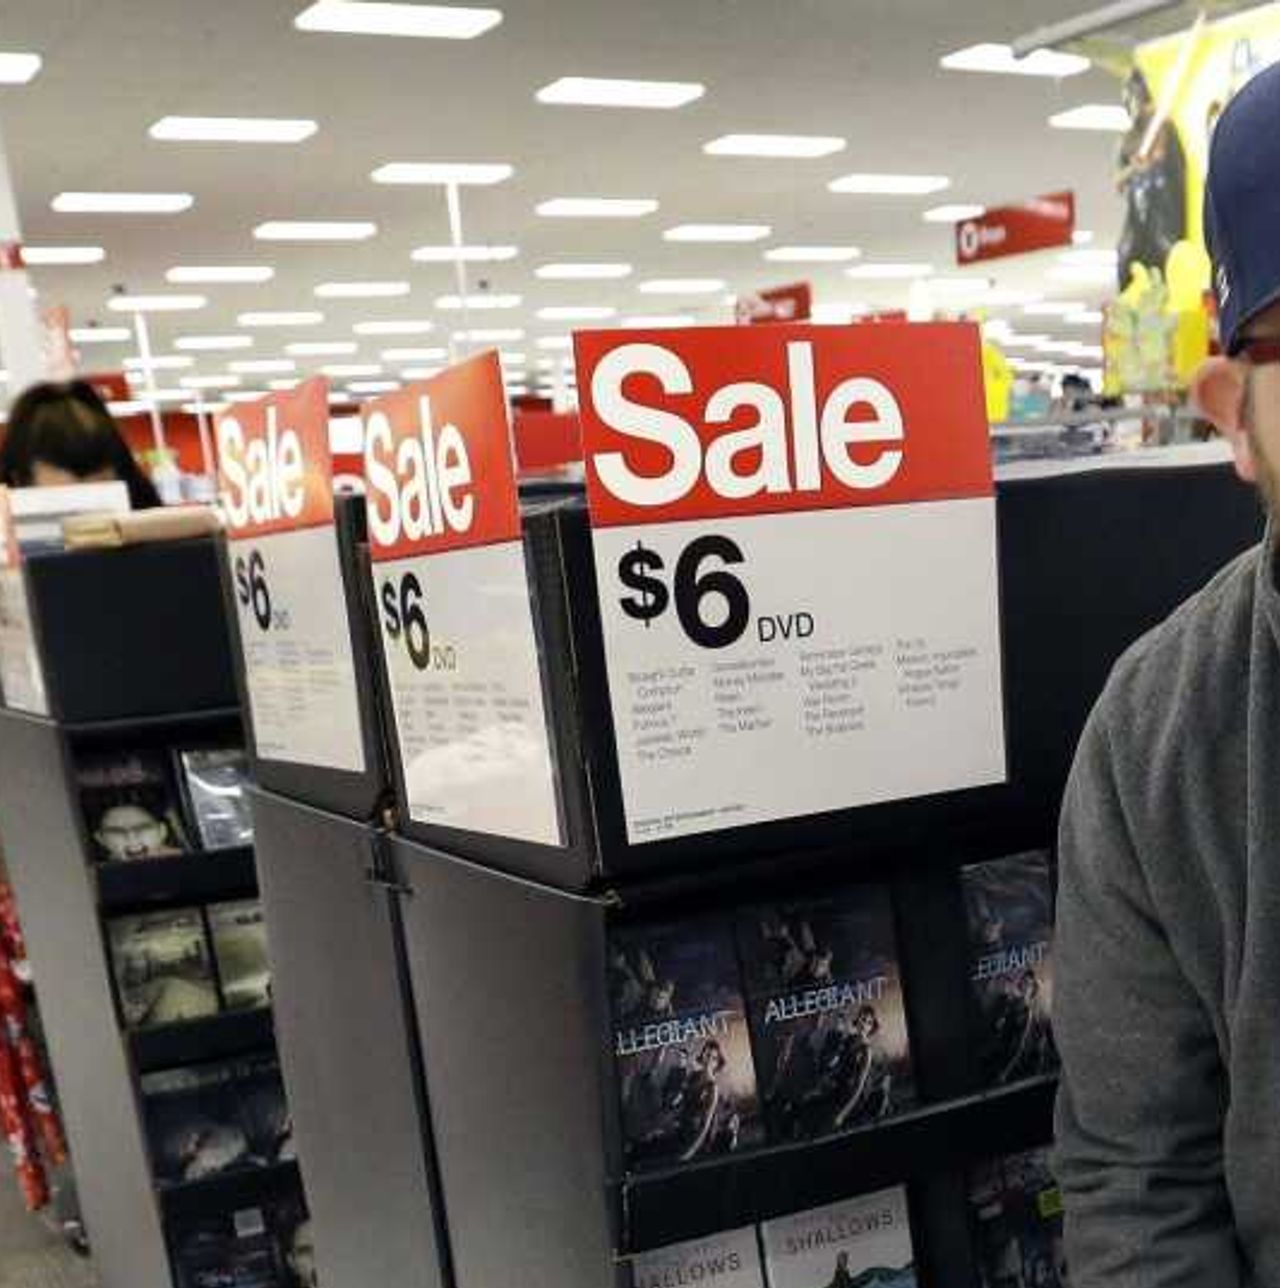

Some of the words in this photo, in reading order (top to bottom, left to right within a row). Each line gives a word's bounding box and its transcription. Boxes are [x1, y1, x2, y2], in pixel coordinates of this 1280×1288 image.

[217, 404, 305, 527] Sale
[364, 396, 474, 547] Sale
[591, 341, 905, 506] Sale
[236, 550, 270, 631] $6
[383, 571, 430, 670] $6
[618, 534, 750, 649] $6
[757, 612, 815, 642] DVD
[616, 1008, 736, 1057] LLEGIANT
[786, 1208, 894, 1254] SHALLOWS
